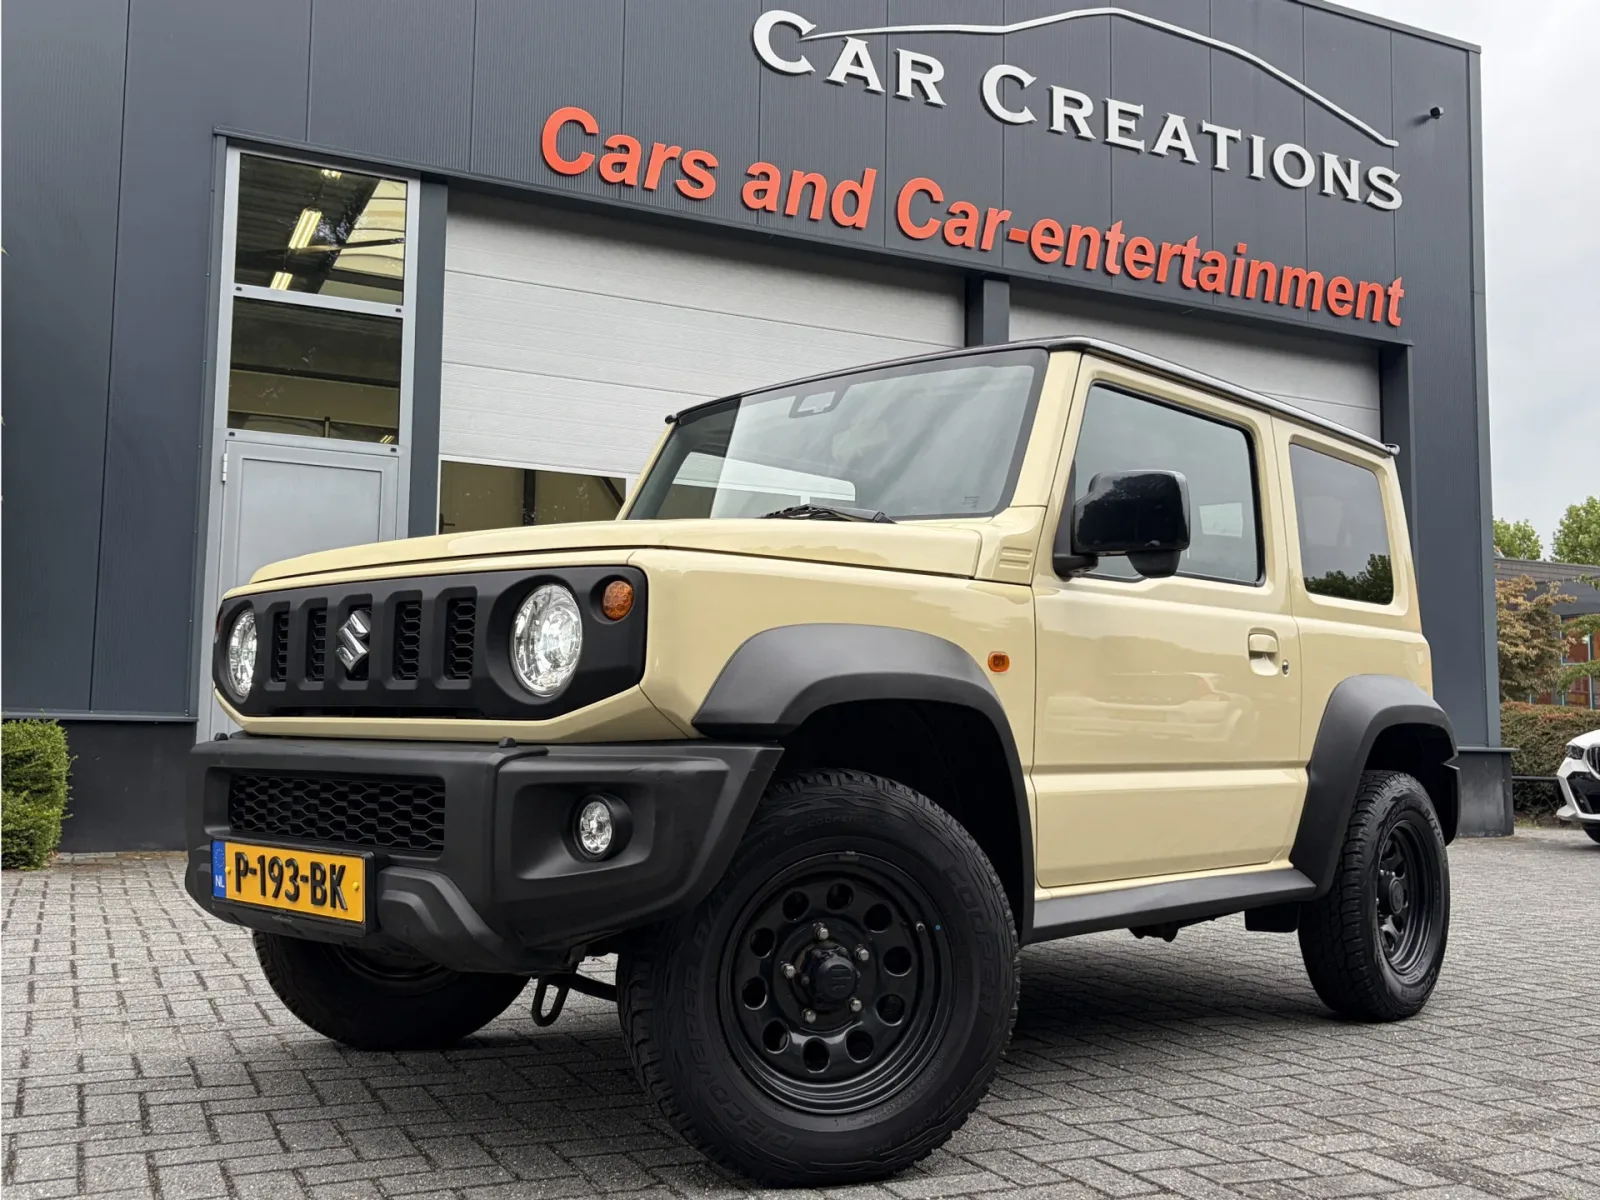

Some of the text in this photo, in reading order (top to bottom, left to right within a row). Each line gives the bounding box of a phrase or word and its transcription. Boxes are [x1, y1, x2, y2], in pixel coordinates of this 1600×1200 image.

[752, 9, 1403, 212] CAR CREATIONS
[541, 106, 1405, 327] Cars and Car-entertainment
[215, 875, 226, 888] NL
[234, 851, 349, 911] P-193-BK
